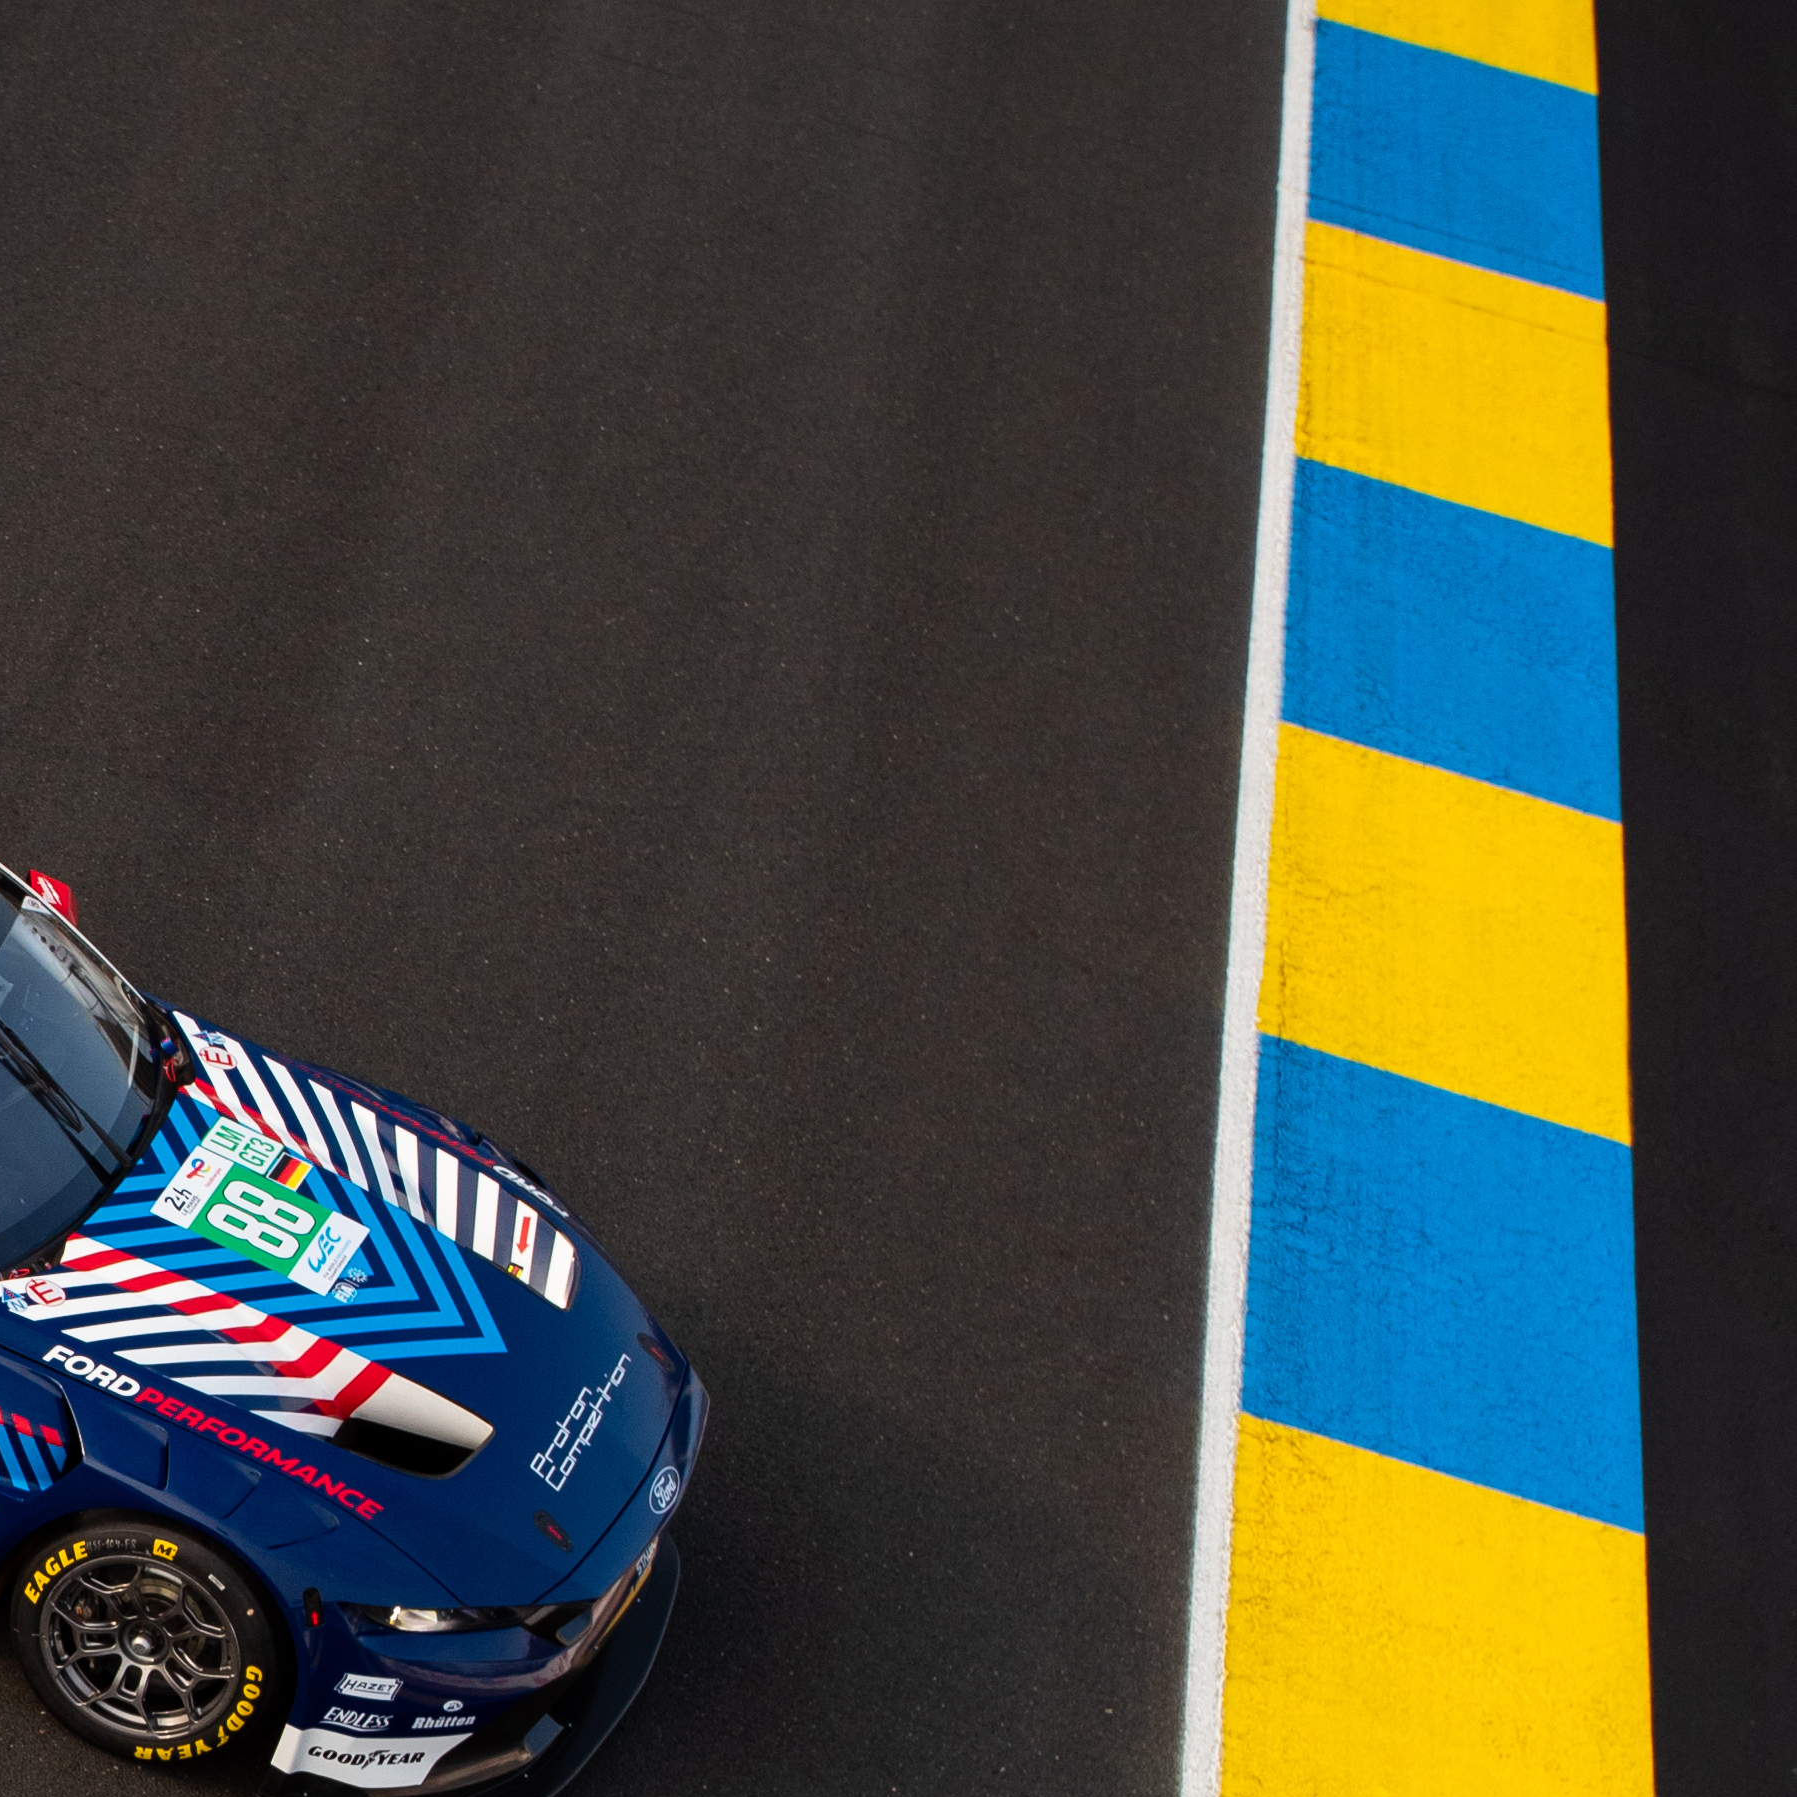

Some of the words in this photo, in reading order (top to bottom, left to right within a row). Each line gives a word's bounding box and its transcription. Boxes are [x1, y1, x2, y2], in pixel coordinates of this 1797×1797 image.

[210, 1125, 245, 1152] LM
[239, 1137, 275, 1167] GT3
[206, 1180, 316, 1259] 88
[307, 1226, 342, 1273] WEC
[530, 1387, 593, 1472] Proton
[544, 1353, 631, 1492] Competition
[653, 1473, 677, 1509] Ford
[24, 1540, 88, 1604] EAGLE
[344, 1679, 395, 1693] HAZET
[134, 1665, 263, 1761] GOODYEAR
[323, 1706, 394, 1729] ENDLESS
[411, 1715, 476, 1730] Rhütten
[308, 1746, 426, 1770] GOODYEAR
